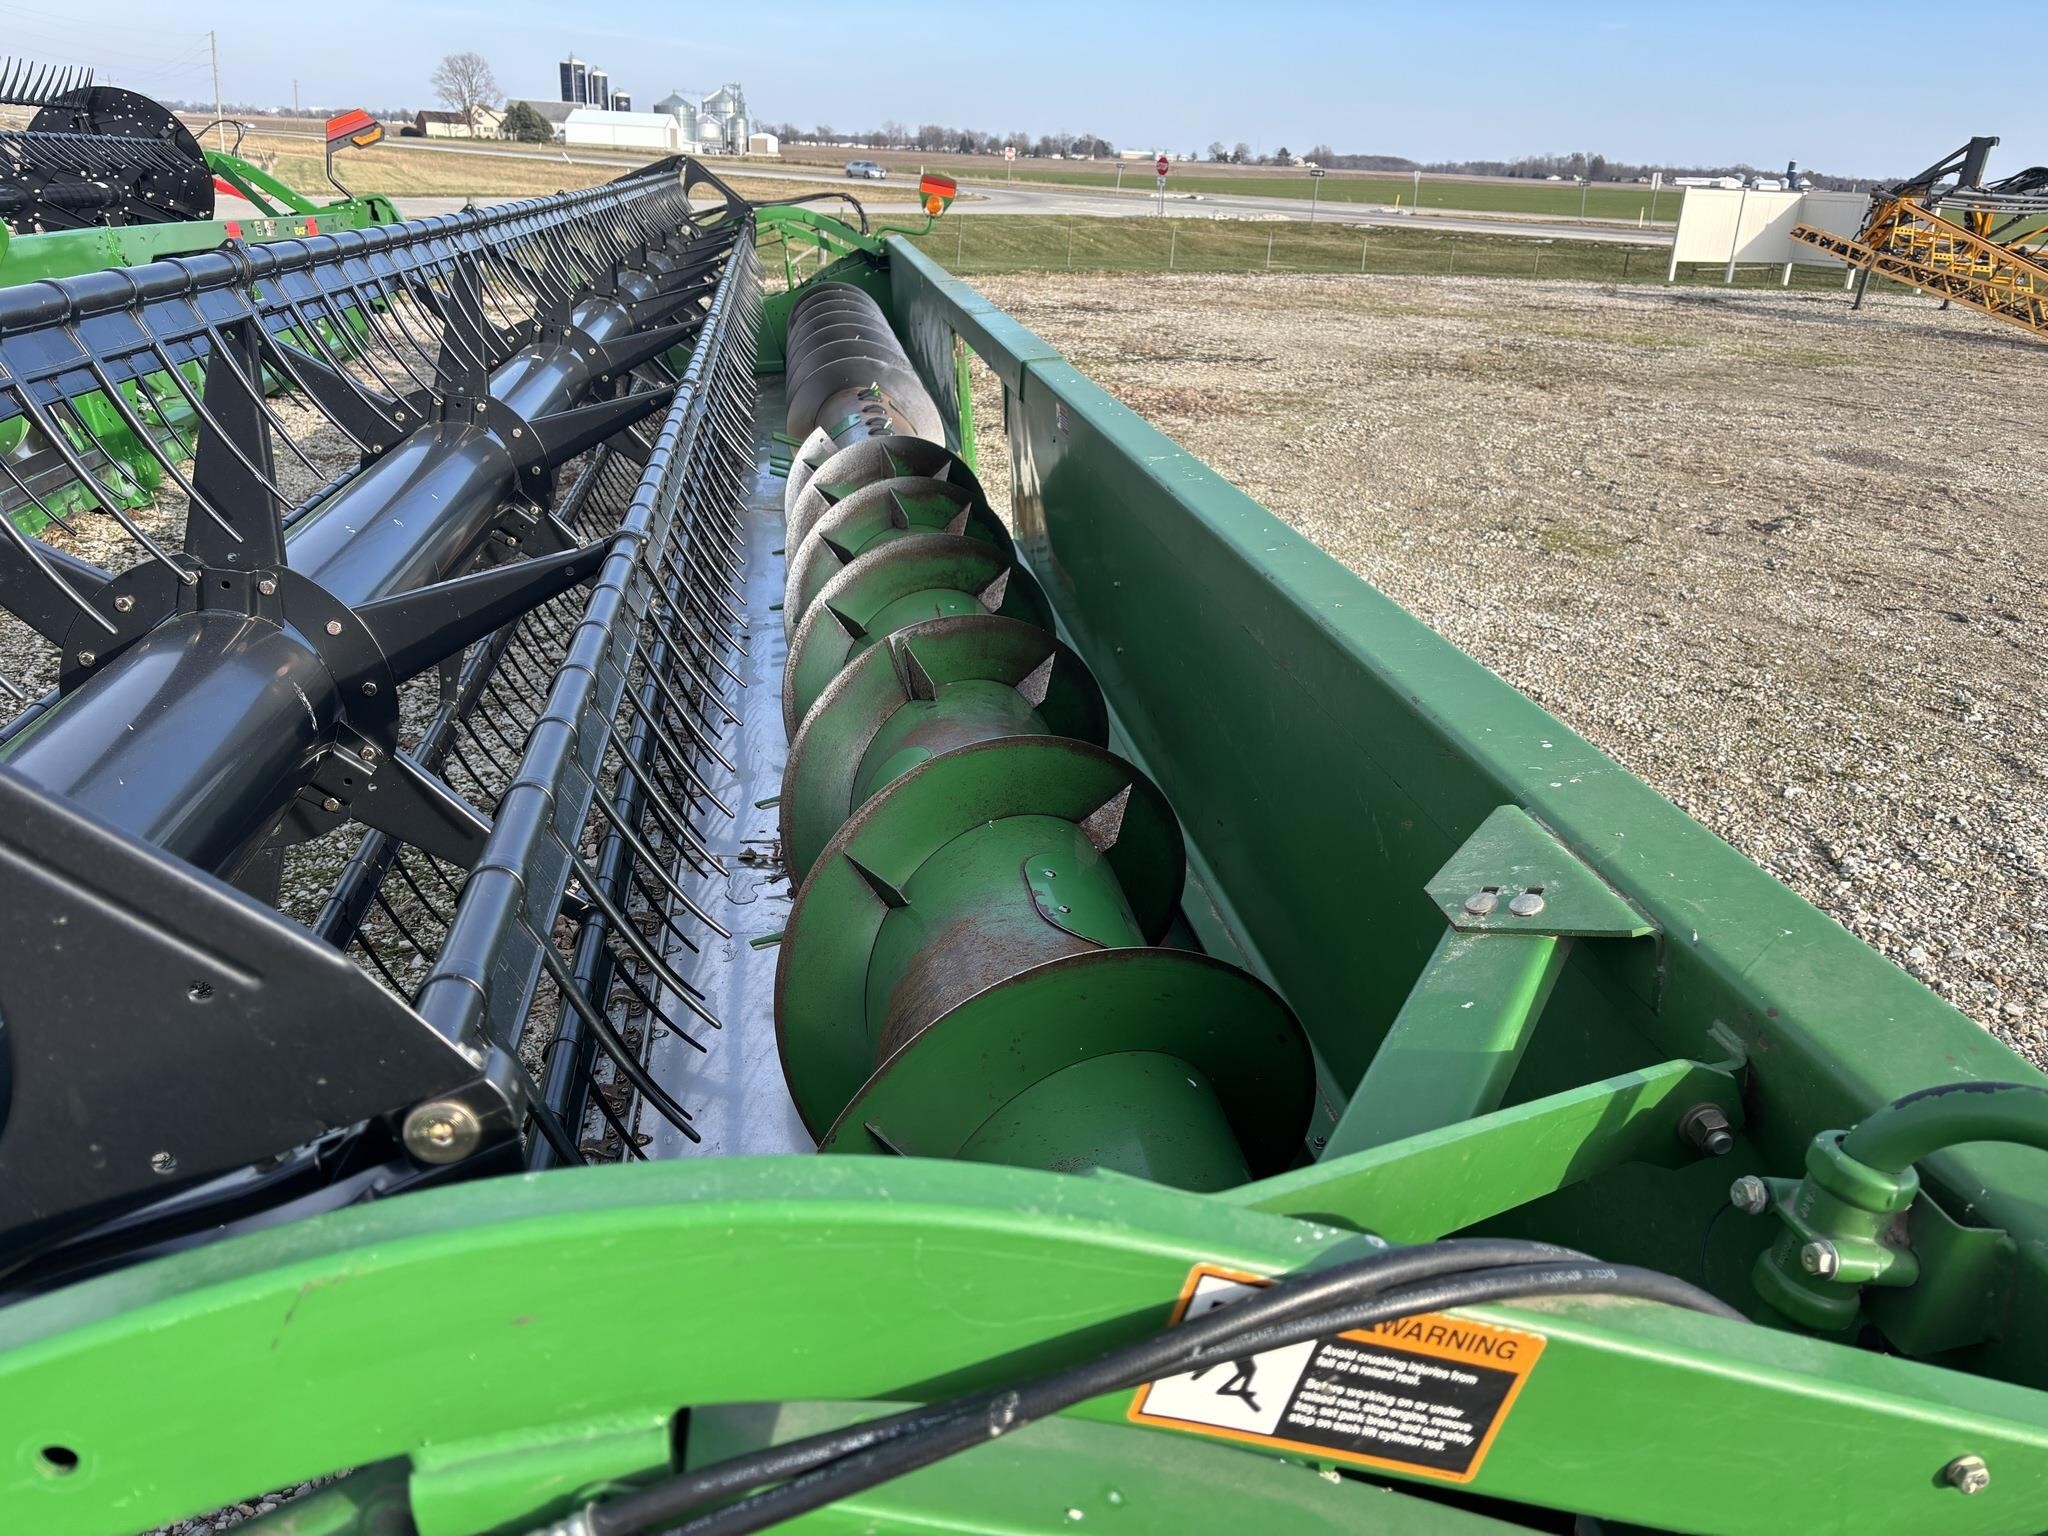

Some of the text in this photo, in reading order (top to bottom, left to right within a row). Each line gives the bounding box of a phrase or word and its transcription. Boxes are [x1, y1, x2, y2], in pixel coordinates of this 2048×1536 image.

[1381, 1319, 1518, 1360] WARNING
[1315, 1355, 1421, 1386] fall of a raised reel.
[1320, 1344, 1478, 1385] Avoid crushing injuries from
[1299, 1390, 1337, 1405] raised
[1362, 1403, 1389, 1416] stop
[1389, 1408, 1429, 1425] engine,
[1430, 1416, 1473, 1432] remove
[1304, 1378, 1464, 1418] Befre working on or under
[1288, 1412, 1446, 1452] stop on each lift cylinder rod.
[1319, 1406, 1338, 1418] set
[1338, 1410, 1366, 1423] park
[1366, 1415, 1398, 1429] brake
[1398, 1422, 1422, 1434] and
[1421, 1427, 1440, 1438] set
[1440, 1430, 1475, 1447] safety
